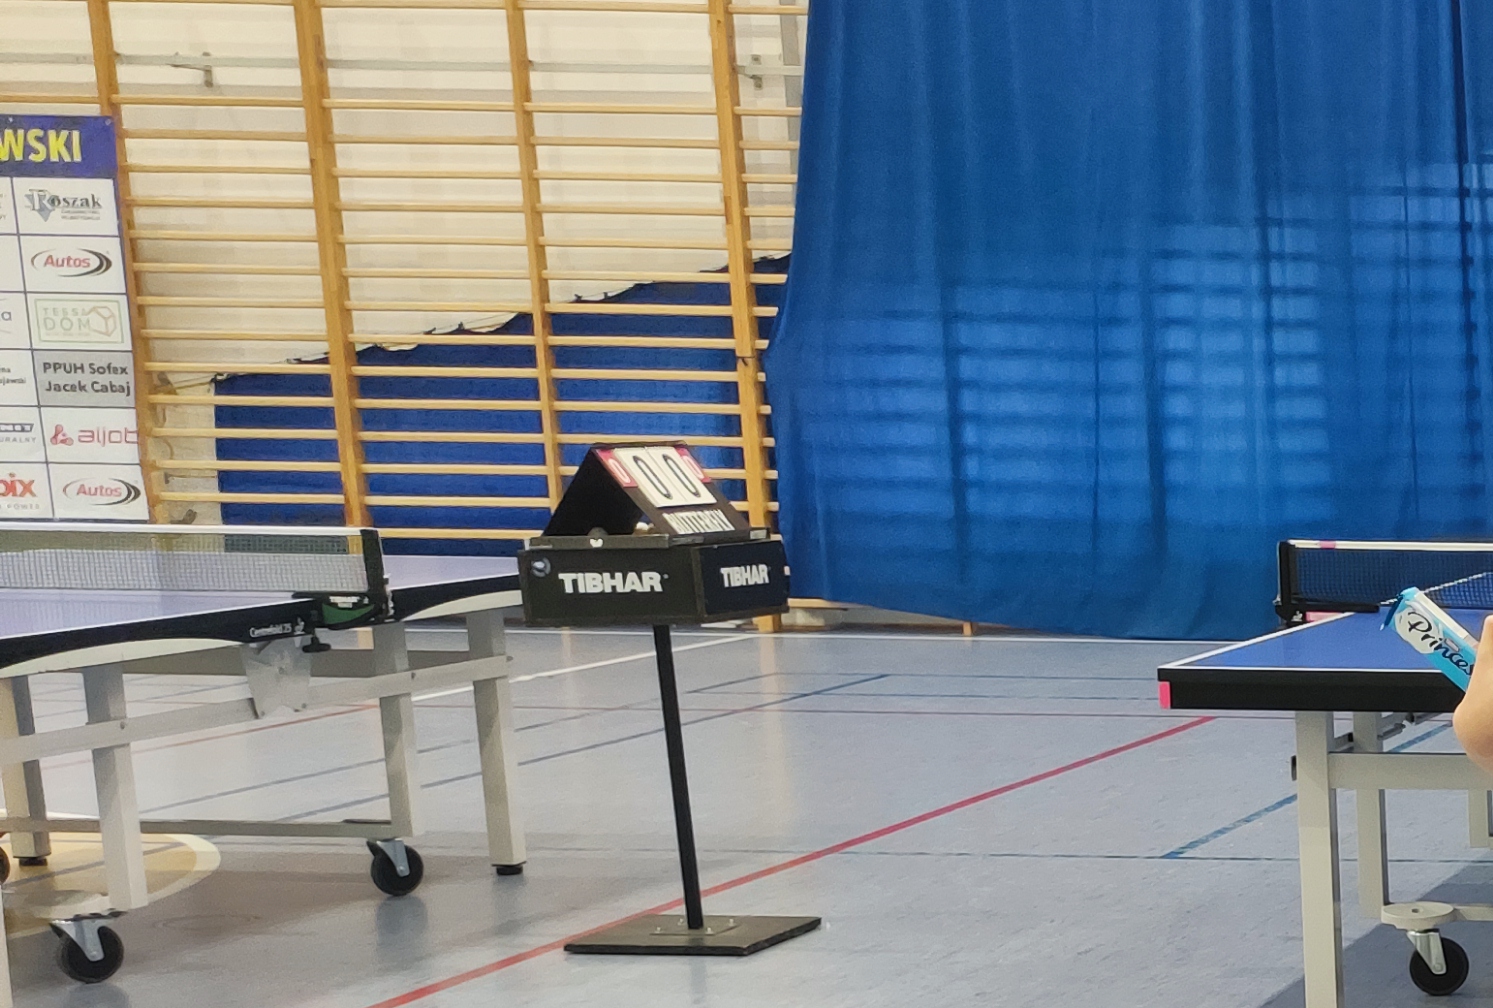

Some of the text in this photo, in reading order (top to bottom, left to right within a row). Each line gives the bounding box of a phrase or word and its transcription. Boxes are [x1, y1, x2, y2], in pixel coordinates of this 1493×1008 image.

[0, 128, 82, 162] WSKI
[28, 189, 102, 211] Roszak
[43, 255, 91, 268] Autos
[44, 317, 91, 331] DOM
[43, 362, 129, 375] PPUH Sofex
[45, 381, 131, 397] Jacek Cabaj
[609, 454, 704, 499] 0 0 0 0
[76, 484, 122, 497] Autos
[558, 572, 663, 593] TIBHAR
[720, 564, 770, 588] TIBHAR
